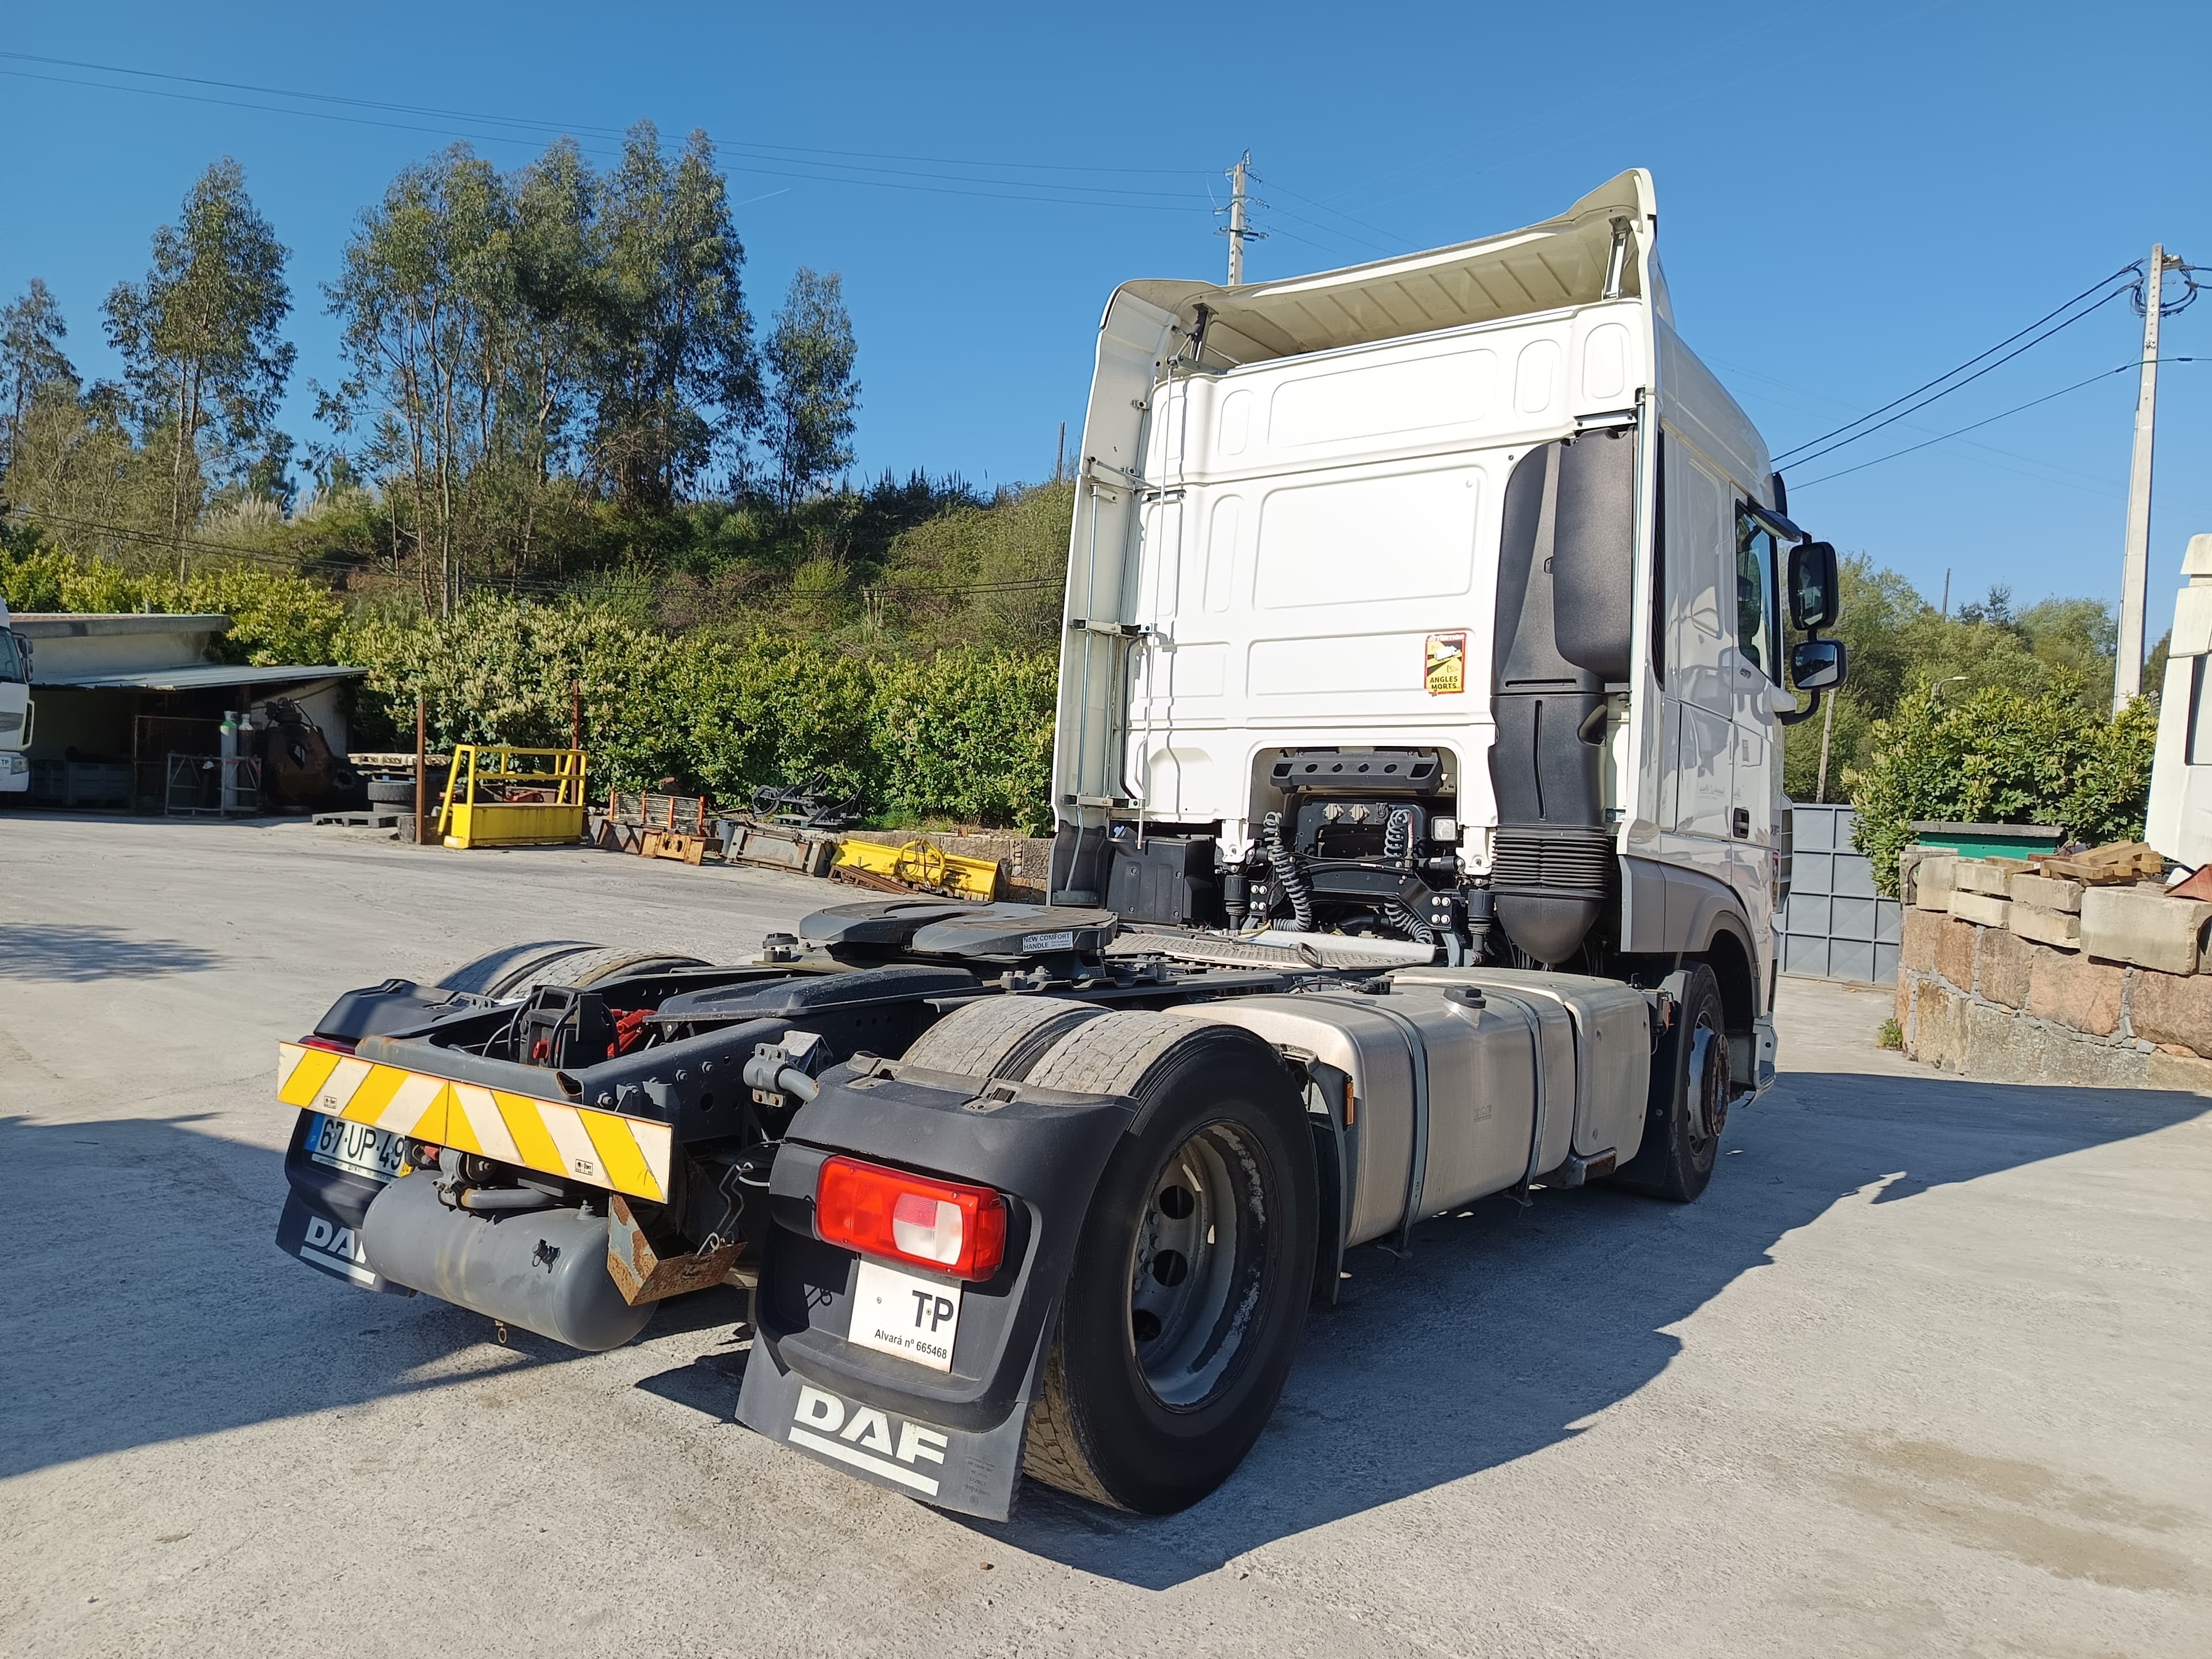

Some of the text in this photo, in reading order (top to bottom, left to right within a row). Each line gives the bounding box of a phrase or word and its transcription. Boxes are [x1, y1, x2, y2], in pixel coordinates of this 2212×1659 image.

[1039, 933, 1070, 941] COMFORT
[304, 1215, 366, 1264] DA
[912, 1290, 954, 1332] TP
[874, 1329, 902, 1345] Alvará
[916, 1341, 947, 1359] 665468
[794, 1385, 949, 1464] DAF
